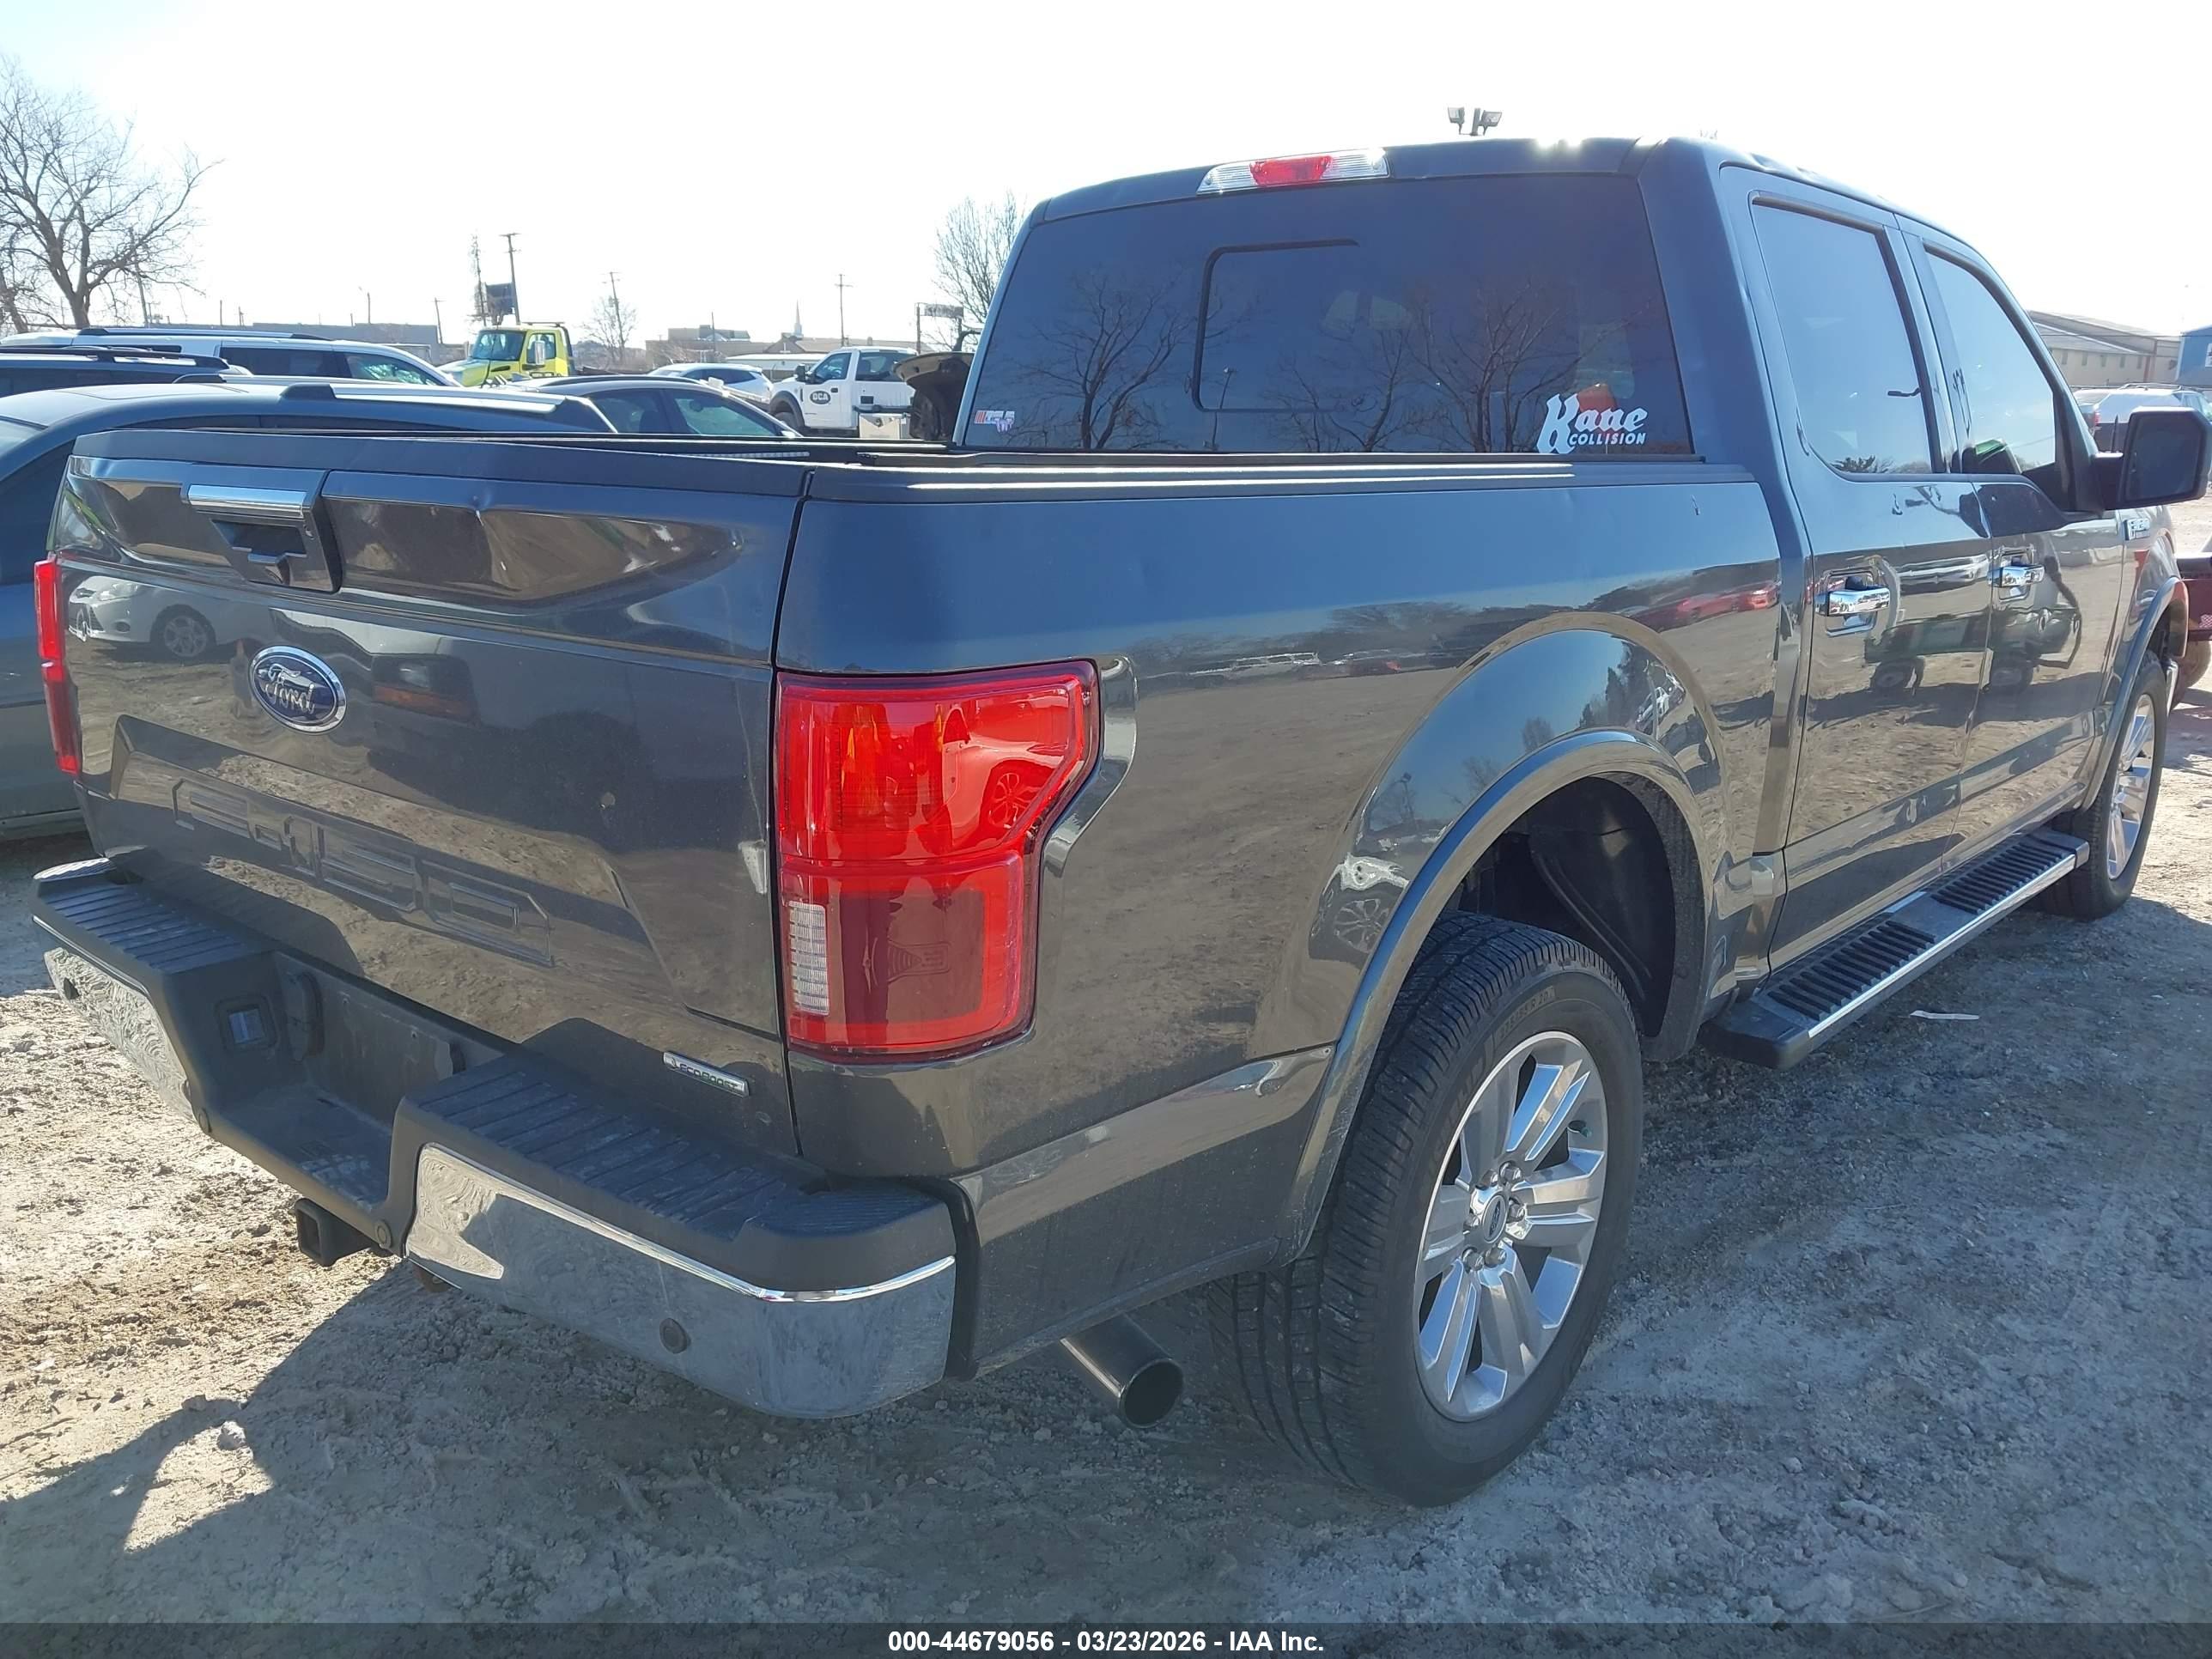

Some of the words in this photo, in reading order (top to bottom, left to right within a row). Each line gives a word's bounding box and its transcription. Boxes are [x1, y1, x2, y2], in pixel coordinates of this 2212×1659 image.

[1536, 393, 1648, 454] Kane
[1569, 432, 1647, 446] COLLISION
[679, 1063, 738, 1090] ECOBOOST
